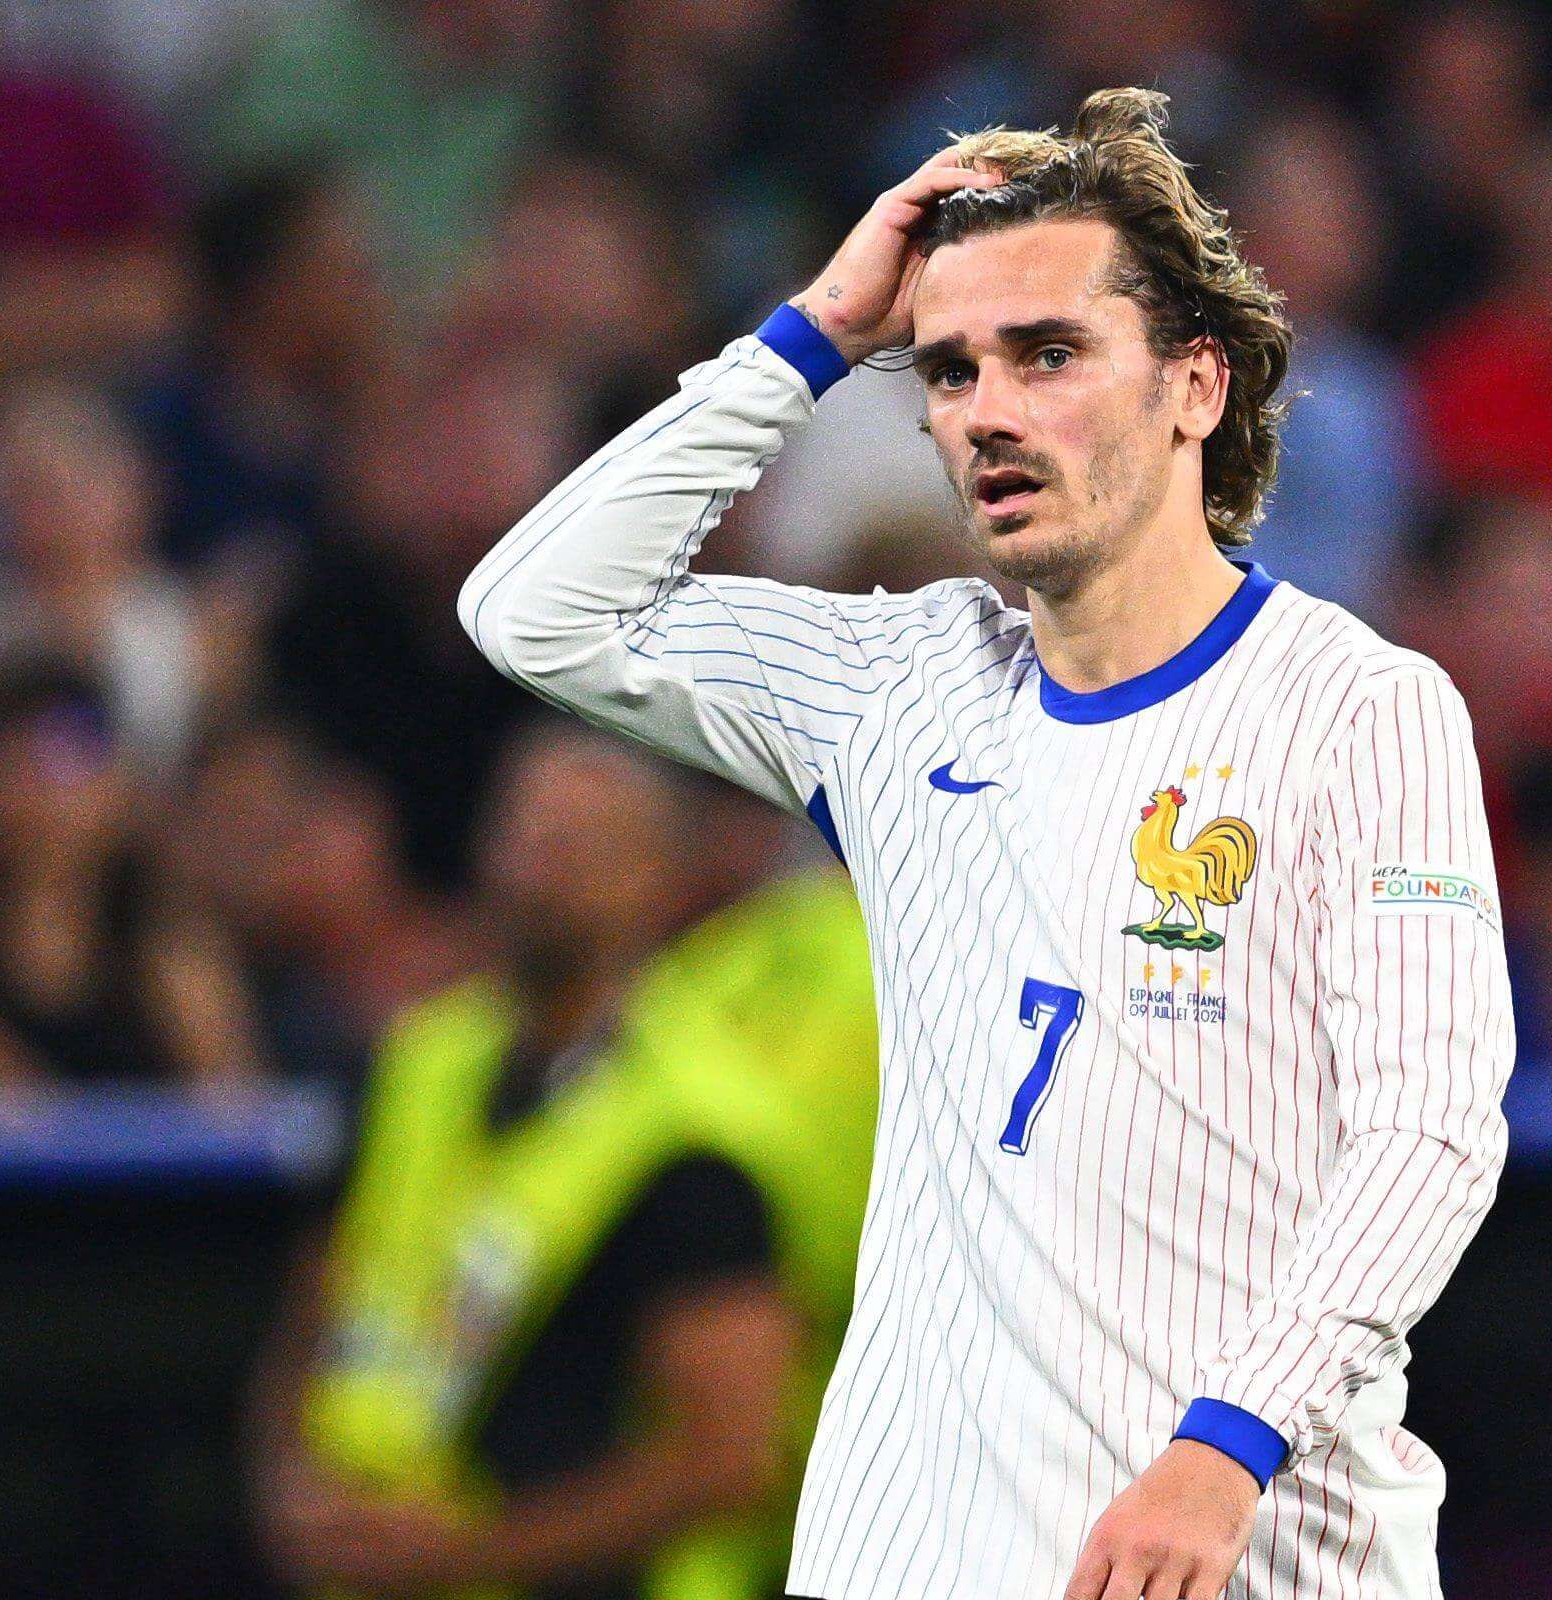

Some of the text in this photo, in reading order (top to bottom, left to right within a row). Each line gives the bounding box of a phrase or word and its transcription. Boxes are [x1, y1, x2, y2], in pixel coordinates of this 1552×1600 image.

[1372, 866, 1408, 878] UEFA
[1130, 988, 1173, 1004] ESPAGNE
[1187, 993, 1227, 1009] FRANCE
[1129, 1004, 1226, 1023] 09 JUILLET 2024
[999, 976, 1085, 1156] 7
